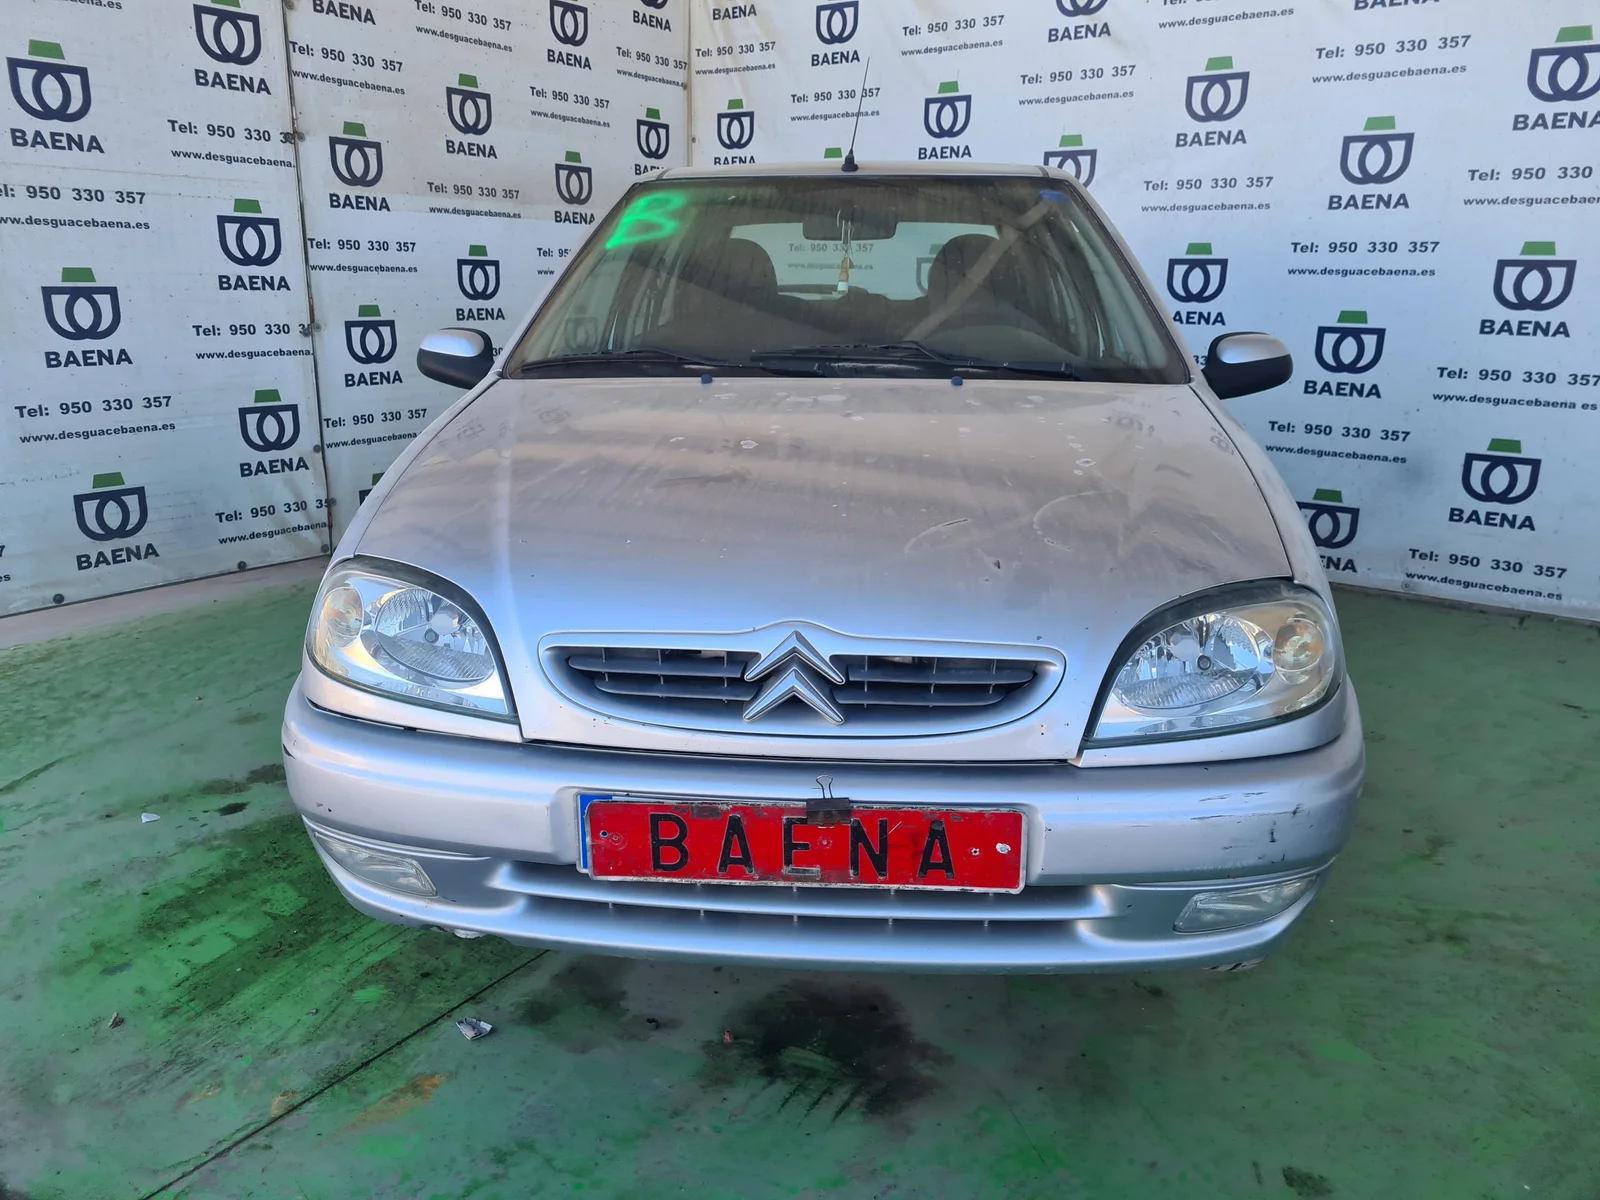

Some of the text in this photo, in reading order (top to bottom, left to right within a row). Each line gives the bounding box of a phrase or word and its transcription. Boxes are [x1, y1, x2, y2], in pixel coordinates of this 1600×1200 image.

[313, 0, 376, 25] BAENA
[414, 0, 511, 30] Tel: 950 330 357
[633, 10, 671, 32] BAENA
[713, 4, 757, 20] BAENA
[1159, 8, 1294, 28] www.desguacebaena.es
[903, 15, 1004, 36] Tel: 950 330 357
[1048, 22, 1111, 42] BAENA
[416, 25, 512, 52] www.desguacebaena.es
[901, 40, 1003, 56] www.desguacebaena.es
[1316, 35, 1471, 59] Tel: 950 330 357
[290, 41, 402, 72] Tel: 950 330 357
[616, 47, 687, 70] Tel: 950 330 357
[695, 41, 776, 57] Tel: 950 330 357
[812, 50, 860, 66] BAENA
[548, 49, 591, 70] BAENA
[695, 64, 775, 75] www.desguacebaena.es
[1021, 65, 1136, 84] Tel: 950 330 357
[1312, 66, 1466, 83] www.desguacebaena.es
[195, 69, 271, 95] BAENA
[292, 70, 405, 95] www.desguacebaena.es
[530, 86, 609, 109] Tel: 950 330 357
[791, 87, 881, 103] Tel: 950 330 357
[1019, 91, 1133, 105] www.desguacebaena.es
[1512, 111, 1600, 131] BAENA
[10, 128, 105, 153] BAENA
[167, 120, 197, 134] Tel:
[207, 124, 235, 138] 950
[244, 128, 271, 142] 330
[1176, 130, 1246, 147] BAENA
[446, 140, 497, 159] BAENA
[918, 145, 971, 160] BAENA
[1468, 166, 1592, 181] Tel: 950 330
[427, 182, 519, 199] Tel: 950 330 357
[1144, 177, 1273, 191] Tel: 950 330 357
[26, 186, 60, 200] 950
[72, 188, 104, 202] 330
[115, 191, 145, 204] 357
[329, 193, 390, 211] BAENA
[1328, 193, 1409, 210] BAENA
[429, 207, 521, 218] www.desguacebaena.es
[1142, 202, 1270, 213] www.desguacebaena.es
[555, 211, 595, 225] BAENA
[307, 238, 416, 252] Tel: 950 330 357
[537, 248, 553, 257] Tel:
[1291, 242, 1440, 253] Tel: 950 330 357
[310, 264, 418, 274] www.desguacebaena.es
[1288, 267, 1435, 277] www.desguacebaena.es
[218, 275, 291, 291] BAENA
[456, 308, 505, 321] BAENA
[1173, 311, 1225, 326] AENA
[192, 325, 220, 336] Tel:
[229, 324, 256, 335] 950
[265, 324, 290, 334] 330
[1479, 319, 1570, 337] BAENA
[45, 349, 133, 368] BAENA
[345, 371, 403, 387] BAENA
[1437, 367, 1600, 386] Tel: 950 330 357
[1304, 380, 1381, 398] BAENA
[15, 396, 171, 418] Tel: 950 330 357
[323, 409, 427, 428] Tel: 950 330 357
[20, 423, 175, 443] www.desguacebaena.es
[1269, 421, 1410, 442] Tel: 950 330 357
[1265, 445, 1407, 464] www.desguacebaena.es
[240, 457, 309, 477] BAENA
[215, 510, 242, 523] Tel:
[251, 505, 275, 518] 950
[284, 501, 307, 513] 330
[1449, 508, 1535, 531] BAENA
[76, 543, 160, 570] BAENA
[1409, 549, 1567, 578] Tel: 950 330 357
[1405, 571, 1563, 600] www.desguacebaena.es
[649, 812, 956, 879] BAENA
